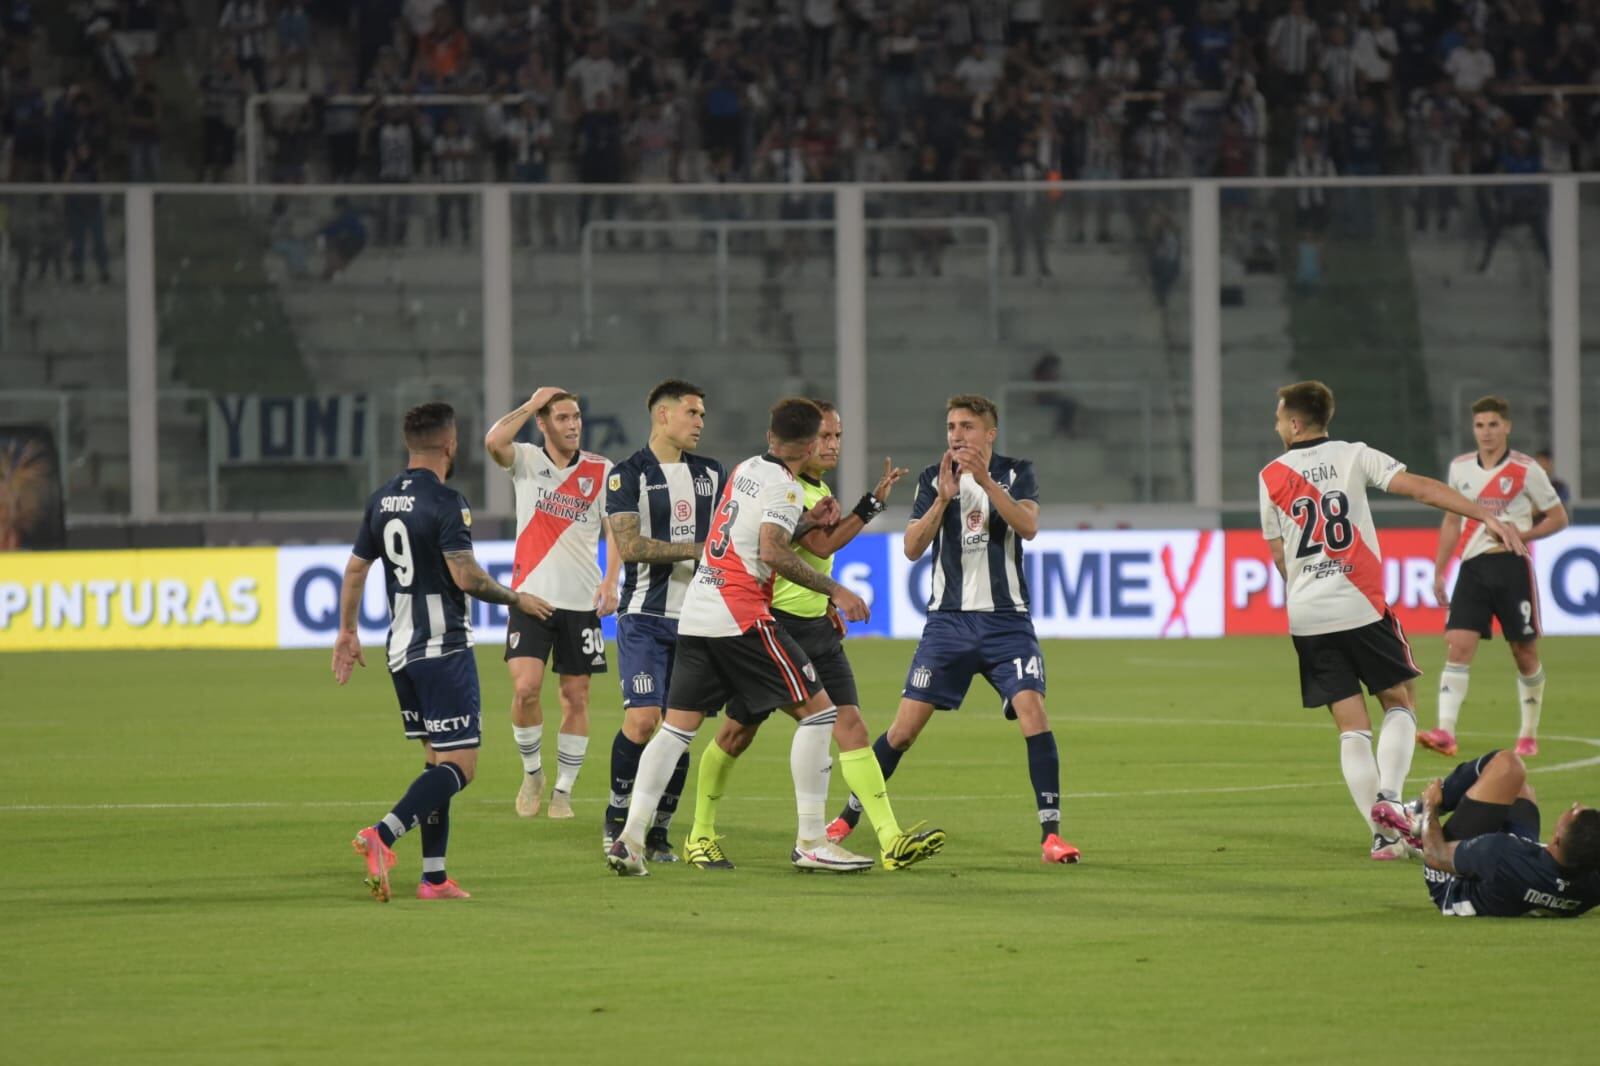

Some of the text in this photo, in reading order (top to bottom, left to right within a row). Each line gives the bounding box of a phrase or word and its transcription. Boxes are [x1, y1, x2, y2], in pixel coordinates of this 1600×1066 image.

[1302, 462, 1339, 485] PEÑA
[380, 495, 416, 513] SANTOS
[537, 486, 591, 511] TURKISH
[535, 500, 588, 523] AIRLINES
[1291, 489, 1354, 559] 28
[671, 525, 696, 537] ICBC
[962, 533, 989, 546] ICBC
[383, 518, 415, 587] 9
[0, 577, 261, 630] PINTURAS
[1519, 600, 1532, 625] 9
[581, 627, 605, 655] 30
[1013, 655, 1041, 680] 14
